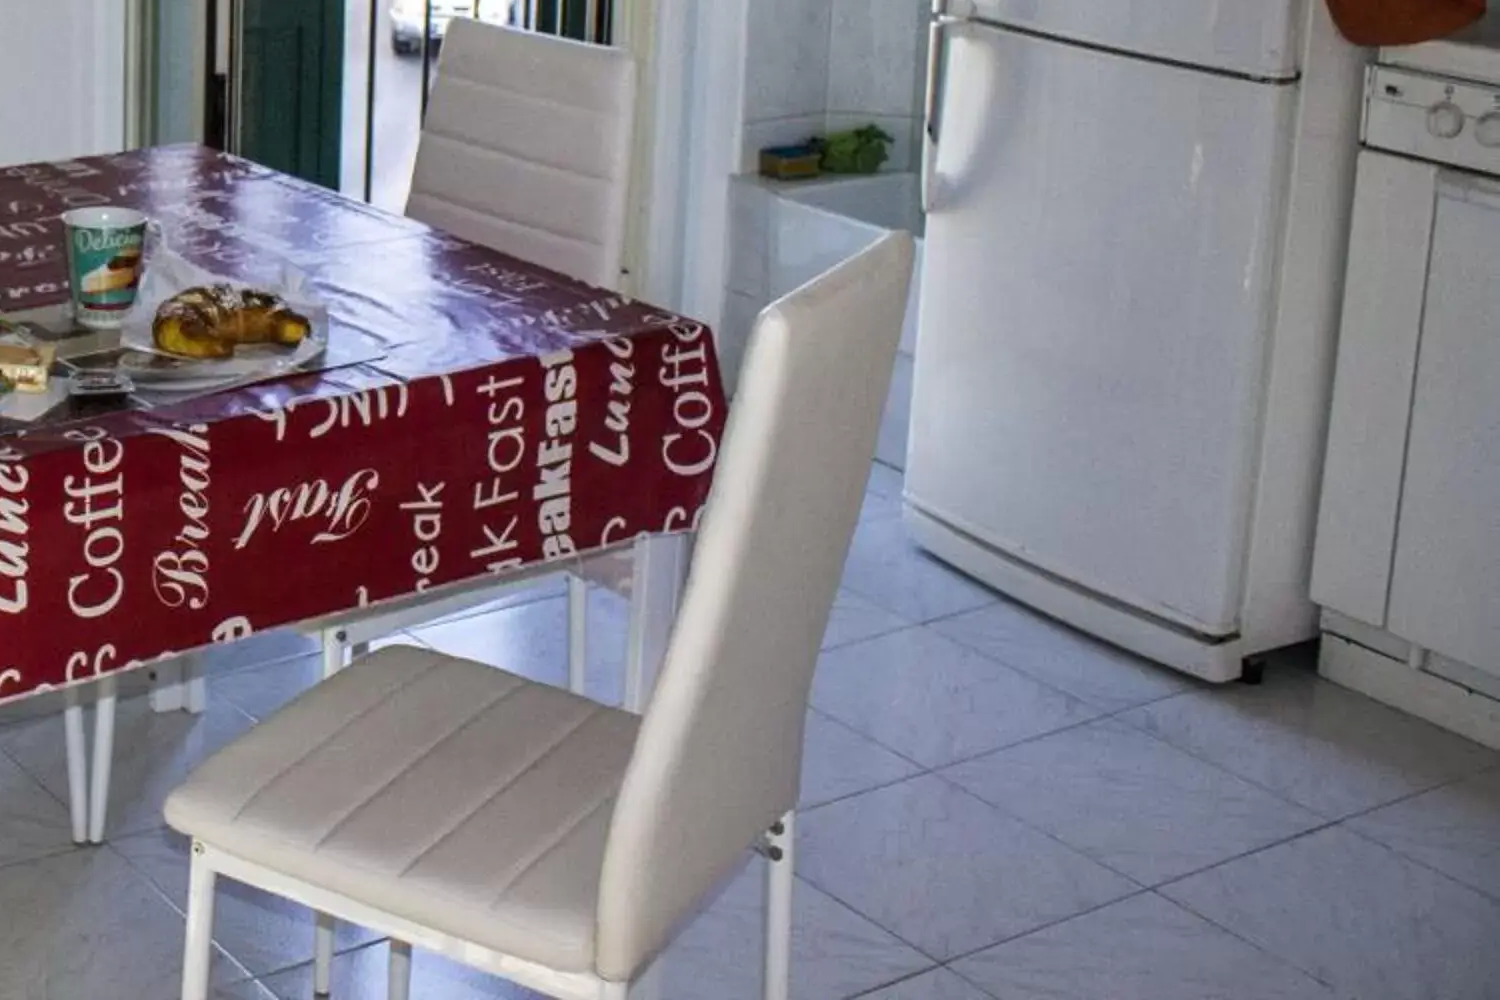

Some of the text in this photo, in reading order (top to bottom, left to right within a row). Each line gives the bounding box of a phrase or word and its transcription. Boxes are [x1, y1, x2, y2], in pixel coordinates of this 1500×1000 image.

[62, 425, 125, 619] Coffee
[152, 424, 211, 609] Break
[233, 468, 379, 550] Fast
